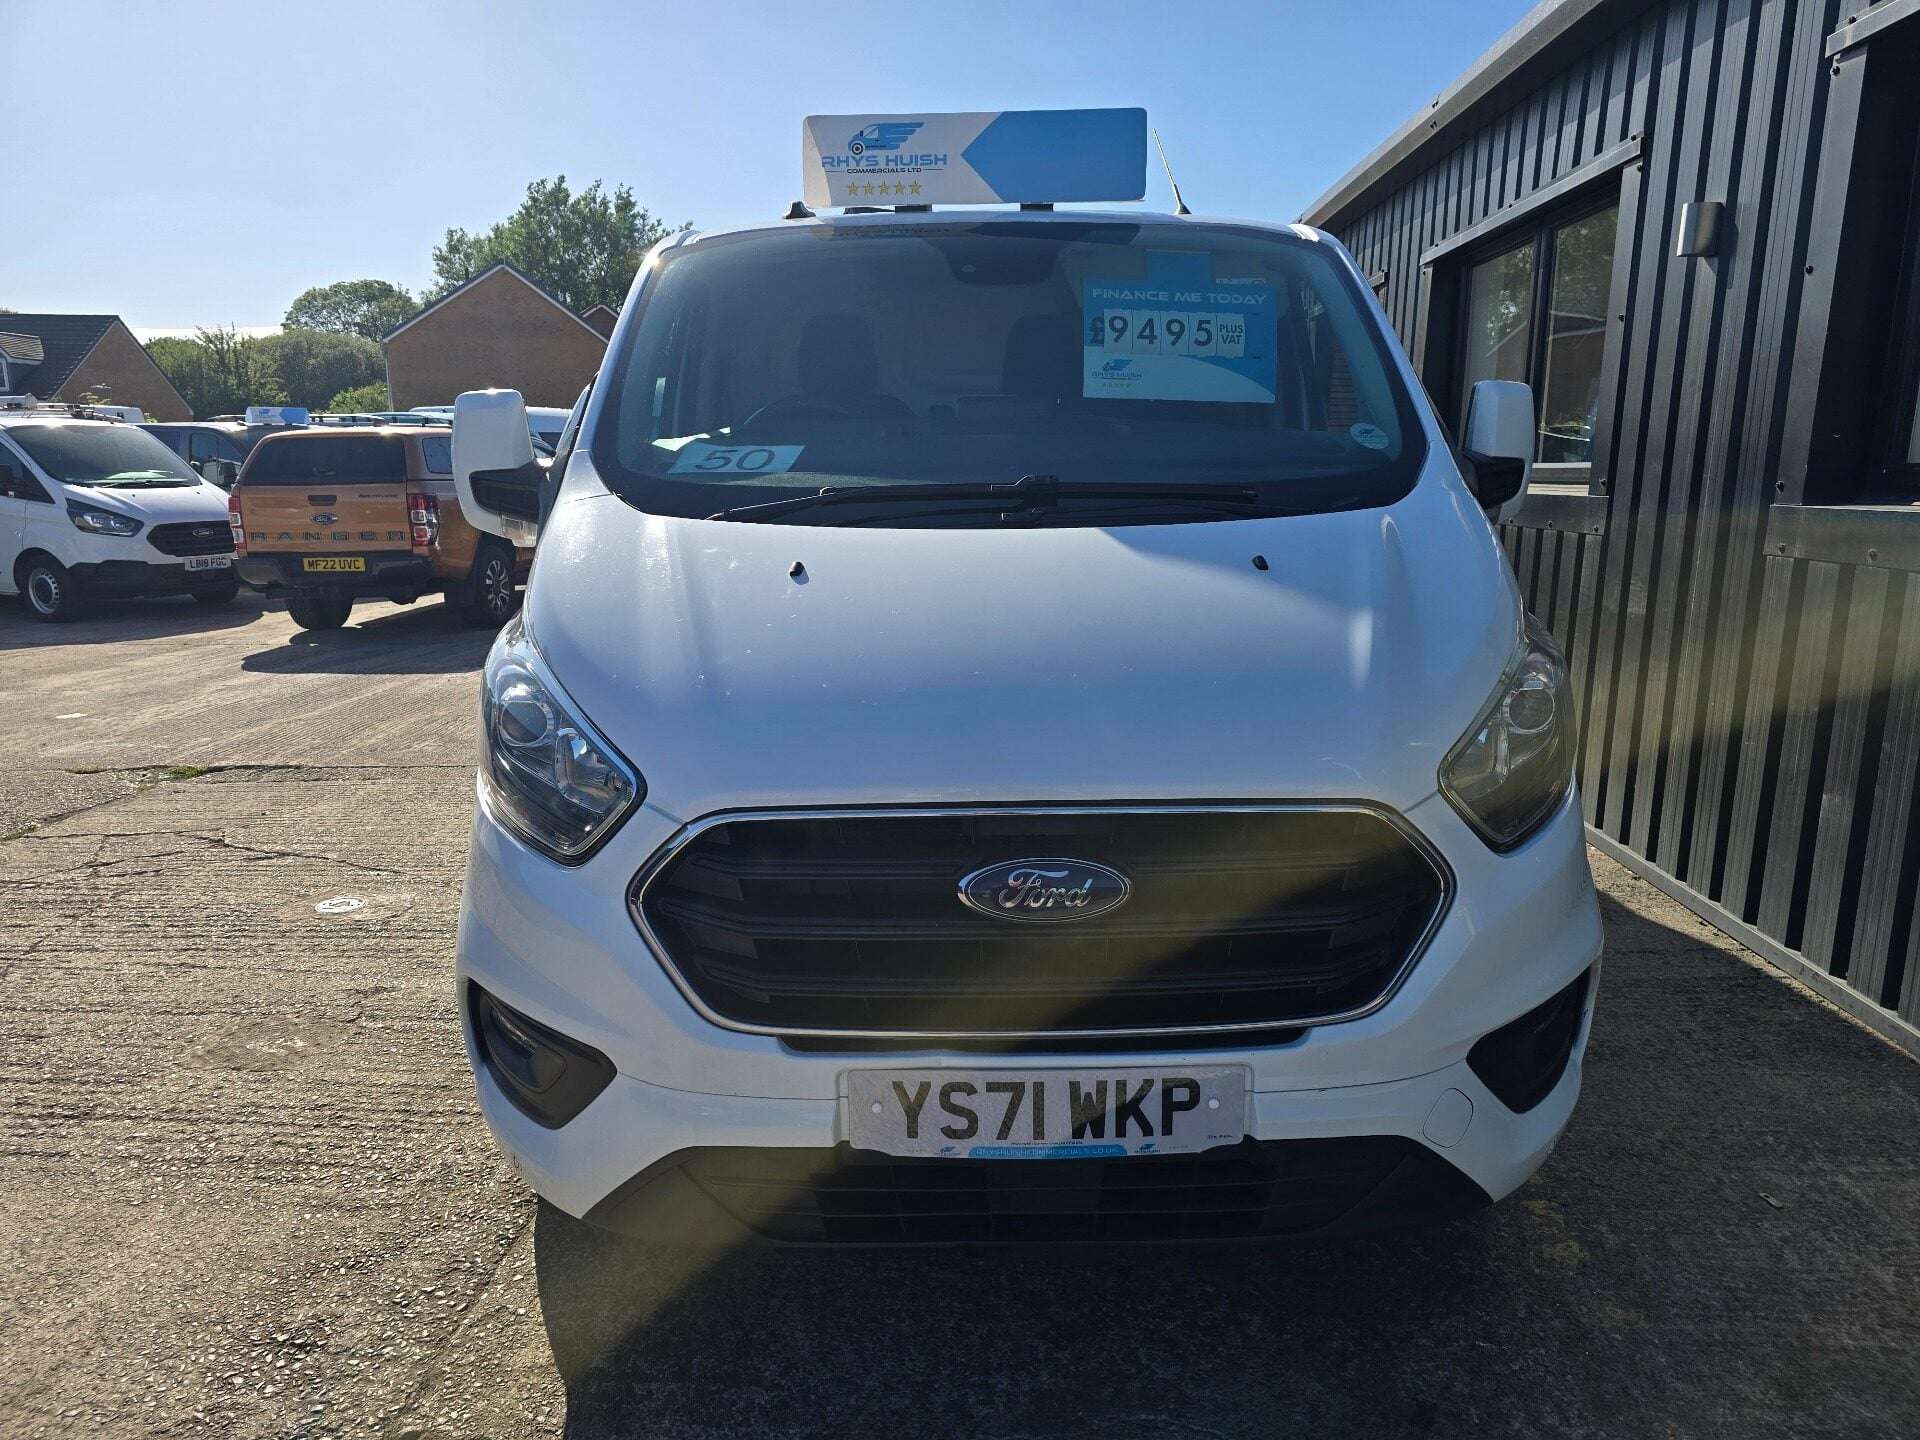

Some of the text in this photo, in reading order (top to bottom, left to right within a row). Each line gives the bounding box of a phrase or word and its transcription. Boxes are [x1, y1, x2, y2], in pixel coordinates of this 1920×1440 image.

[821, 154, 947, 167] RHYS HUISH
[1092, 288, 1266, 304] FINANCE ME TODAY
[1219, 323, 1243, 334] PLUS
[1220, 334, 1242, 344] VAT
[695, 448, 776, 471] 50
[249, 531, 405, 541] RANGER
[307, 559, 361, 570] MF22 UVC
[999, 868, 1094, 908] Ford
[891, 1077, 1201, 1141] YS71 WKP
